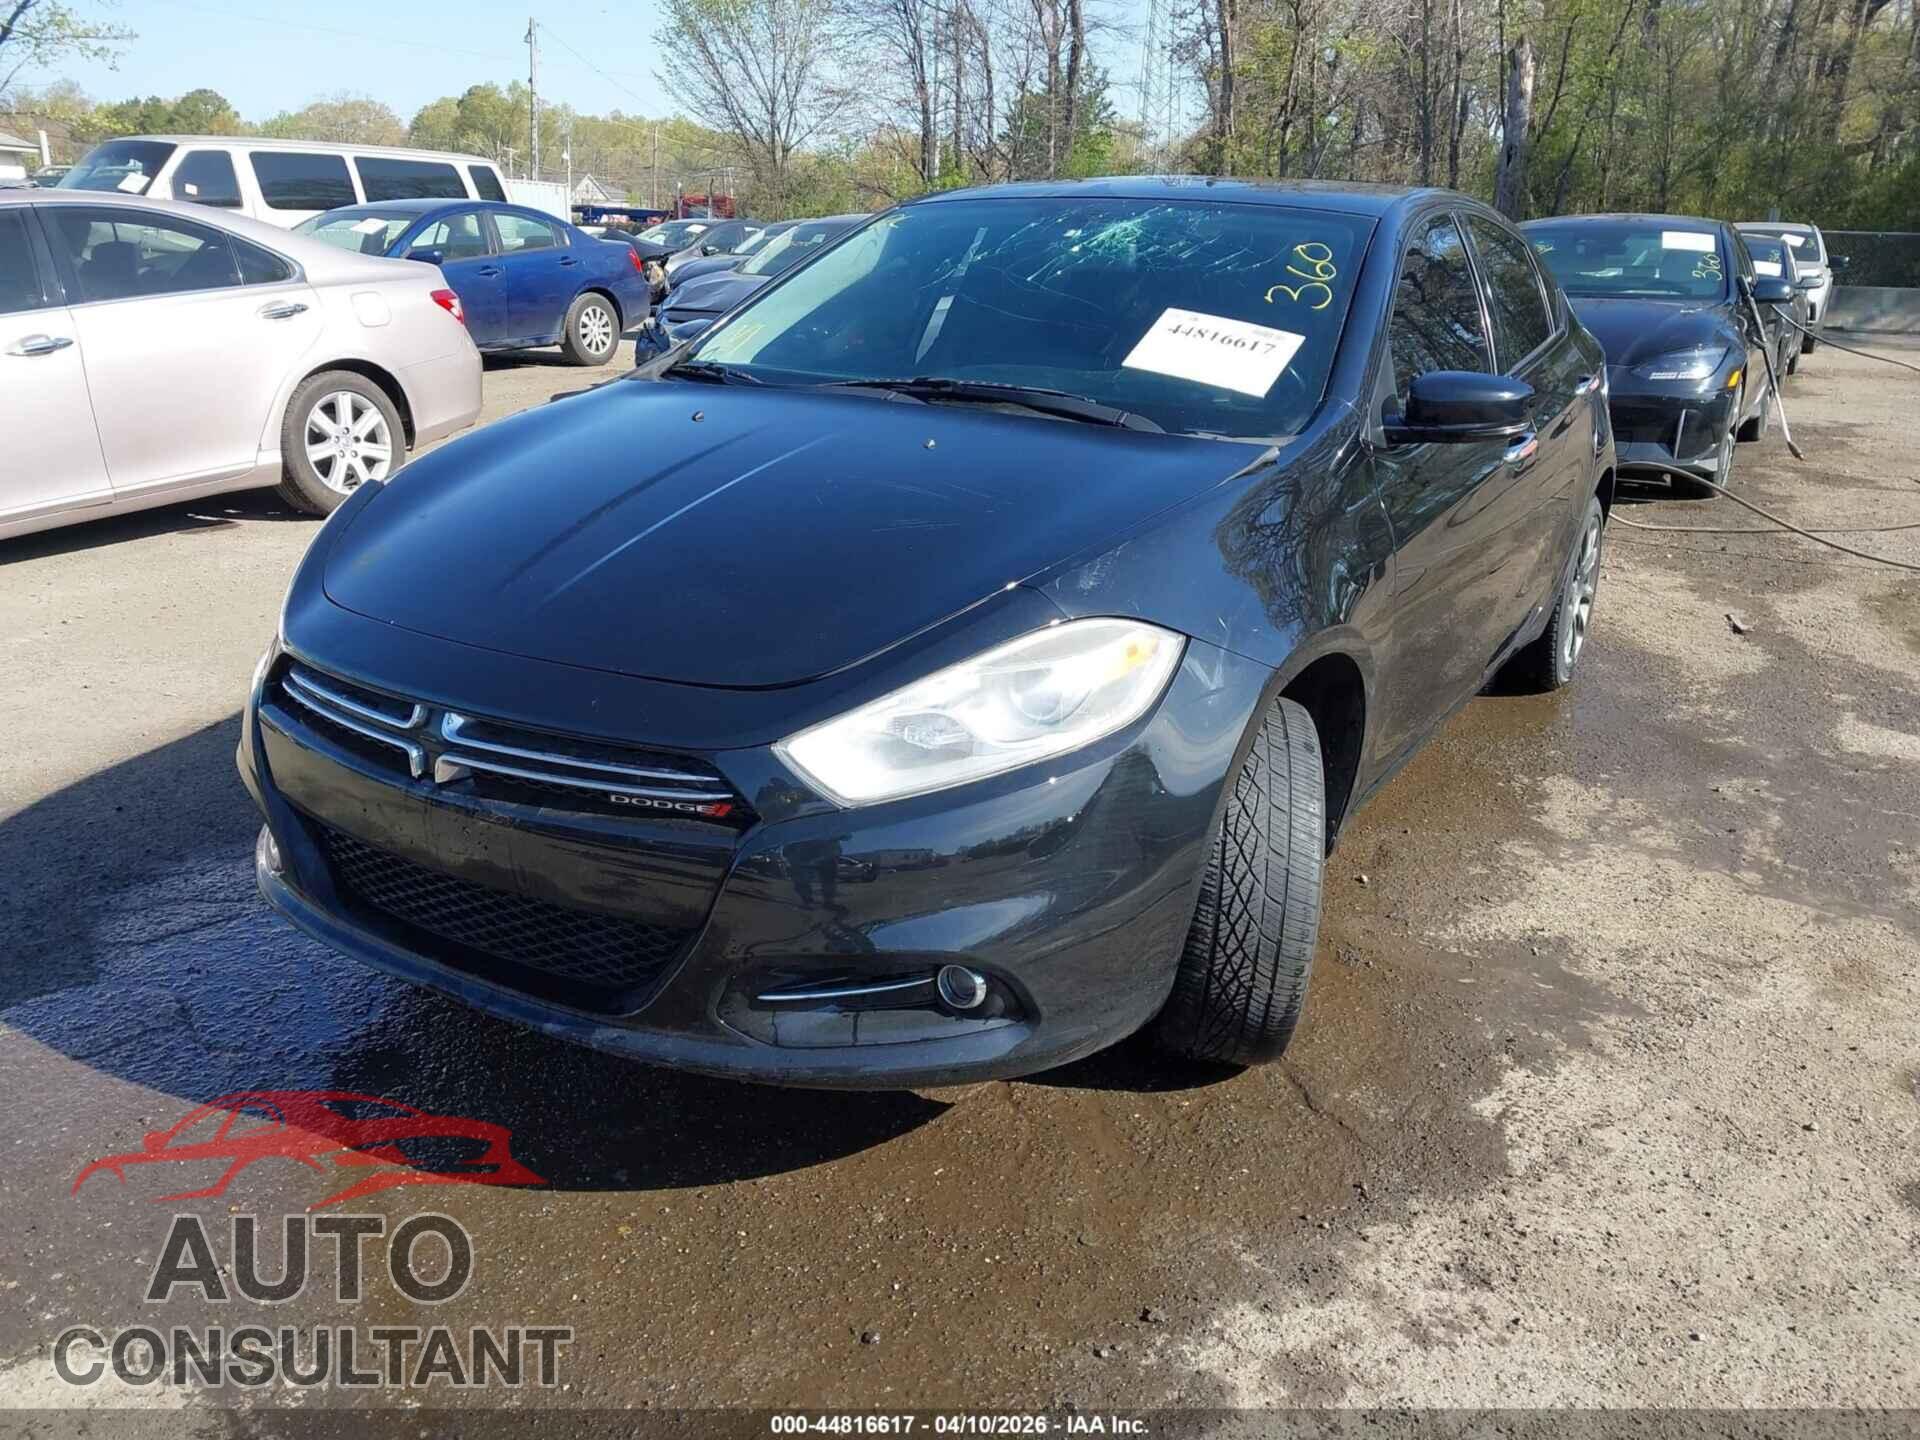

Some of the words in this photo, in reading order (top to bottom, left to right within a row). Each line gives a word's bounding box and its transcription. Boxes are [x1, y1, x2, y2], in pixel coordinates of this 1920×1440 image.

[1263, 242, 1337, 309] 360
[1692, 253, 1722, 281] 360
[1167, 323, 1276, 354] 44816617
[610, 794, 715, 813] DODGE
